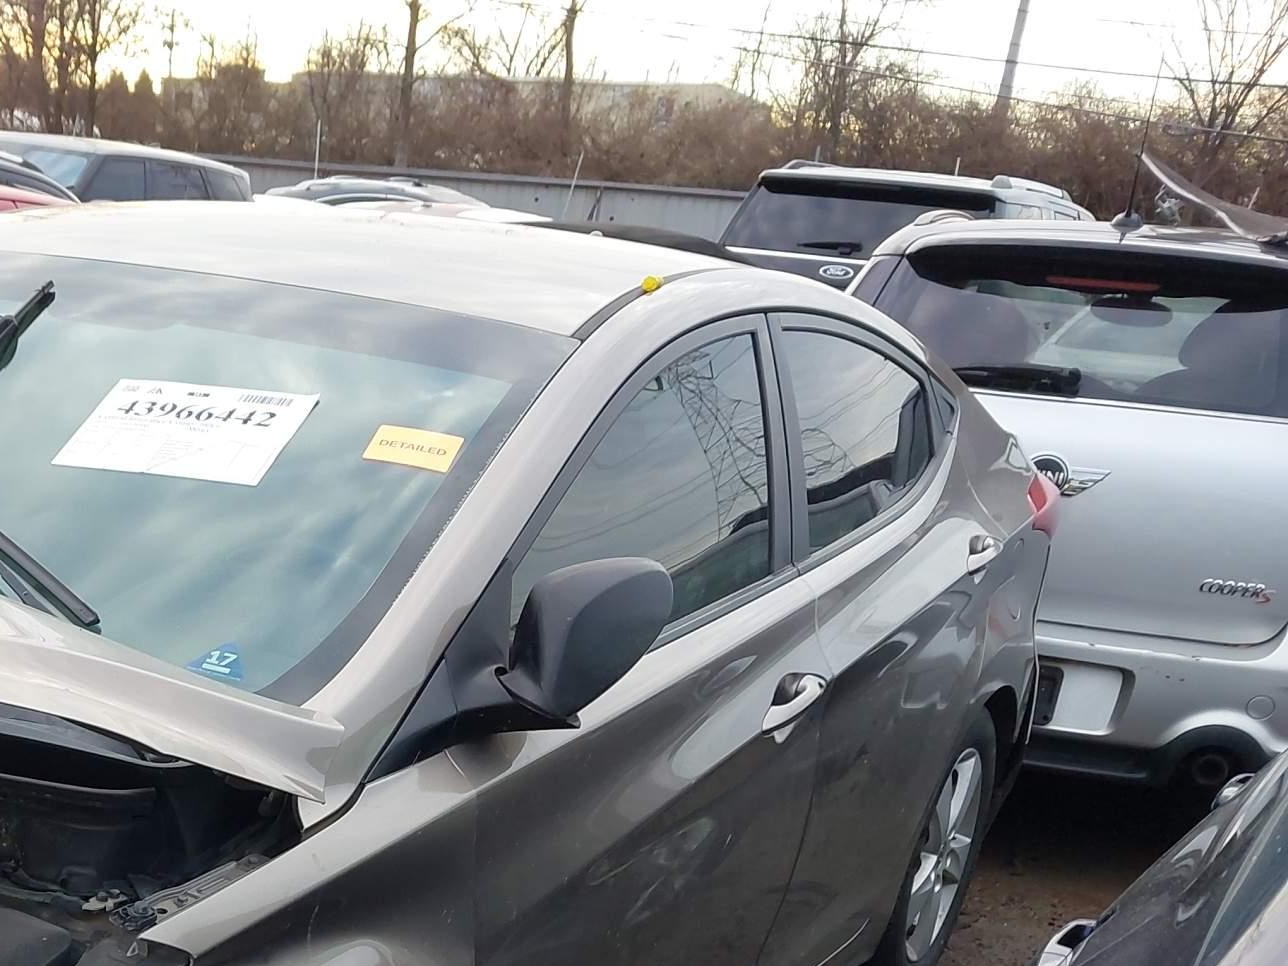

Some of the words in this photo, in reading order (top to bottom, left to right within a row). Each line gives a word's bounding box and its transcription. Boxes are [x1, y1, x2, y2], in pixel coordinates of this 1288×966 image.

[117, 400, 277, 428] 43966442
[378, 439, 448, 456] DETAILED
[1199, 578, 1266, 599] COOPER
[205, 650, 238, 666] 17
